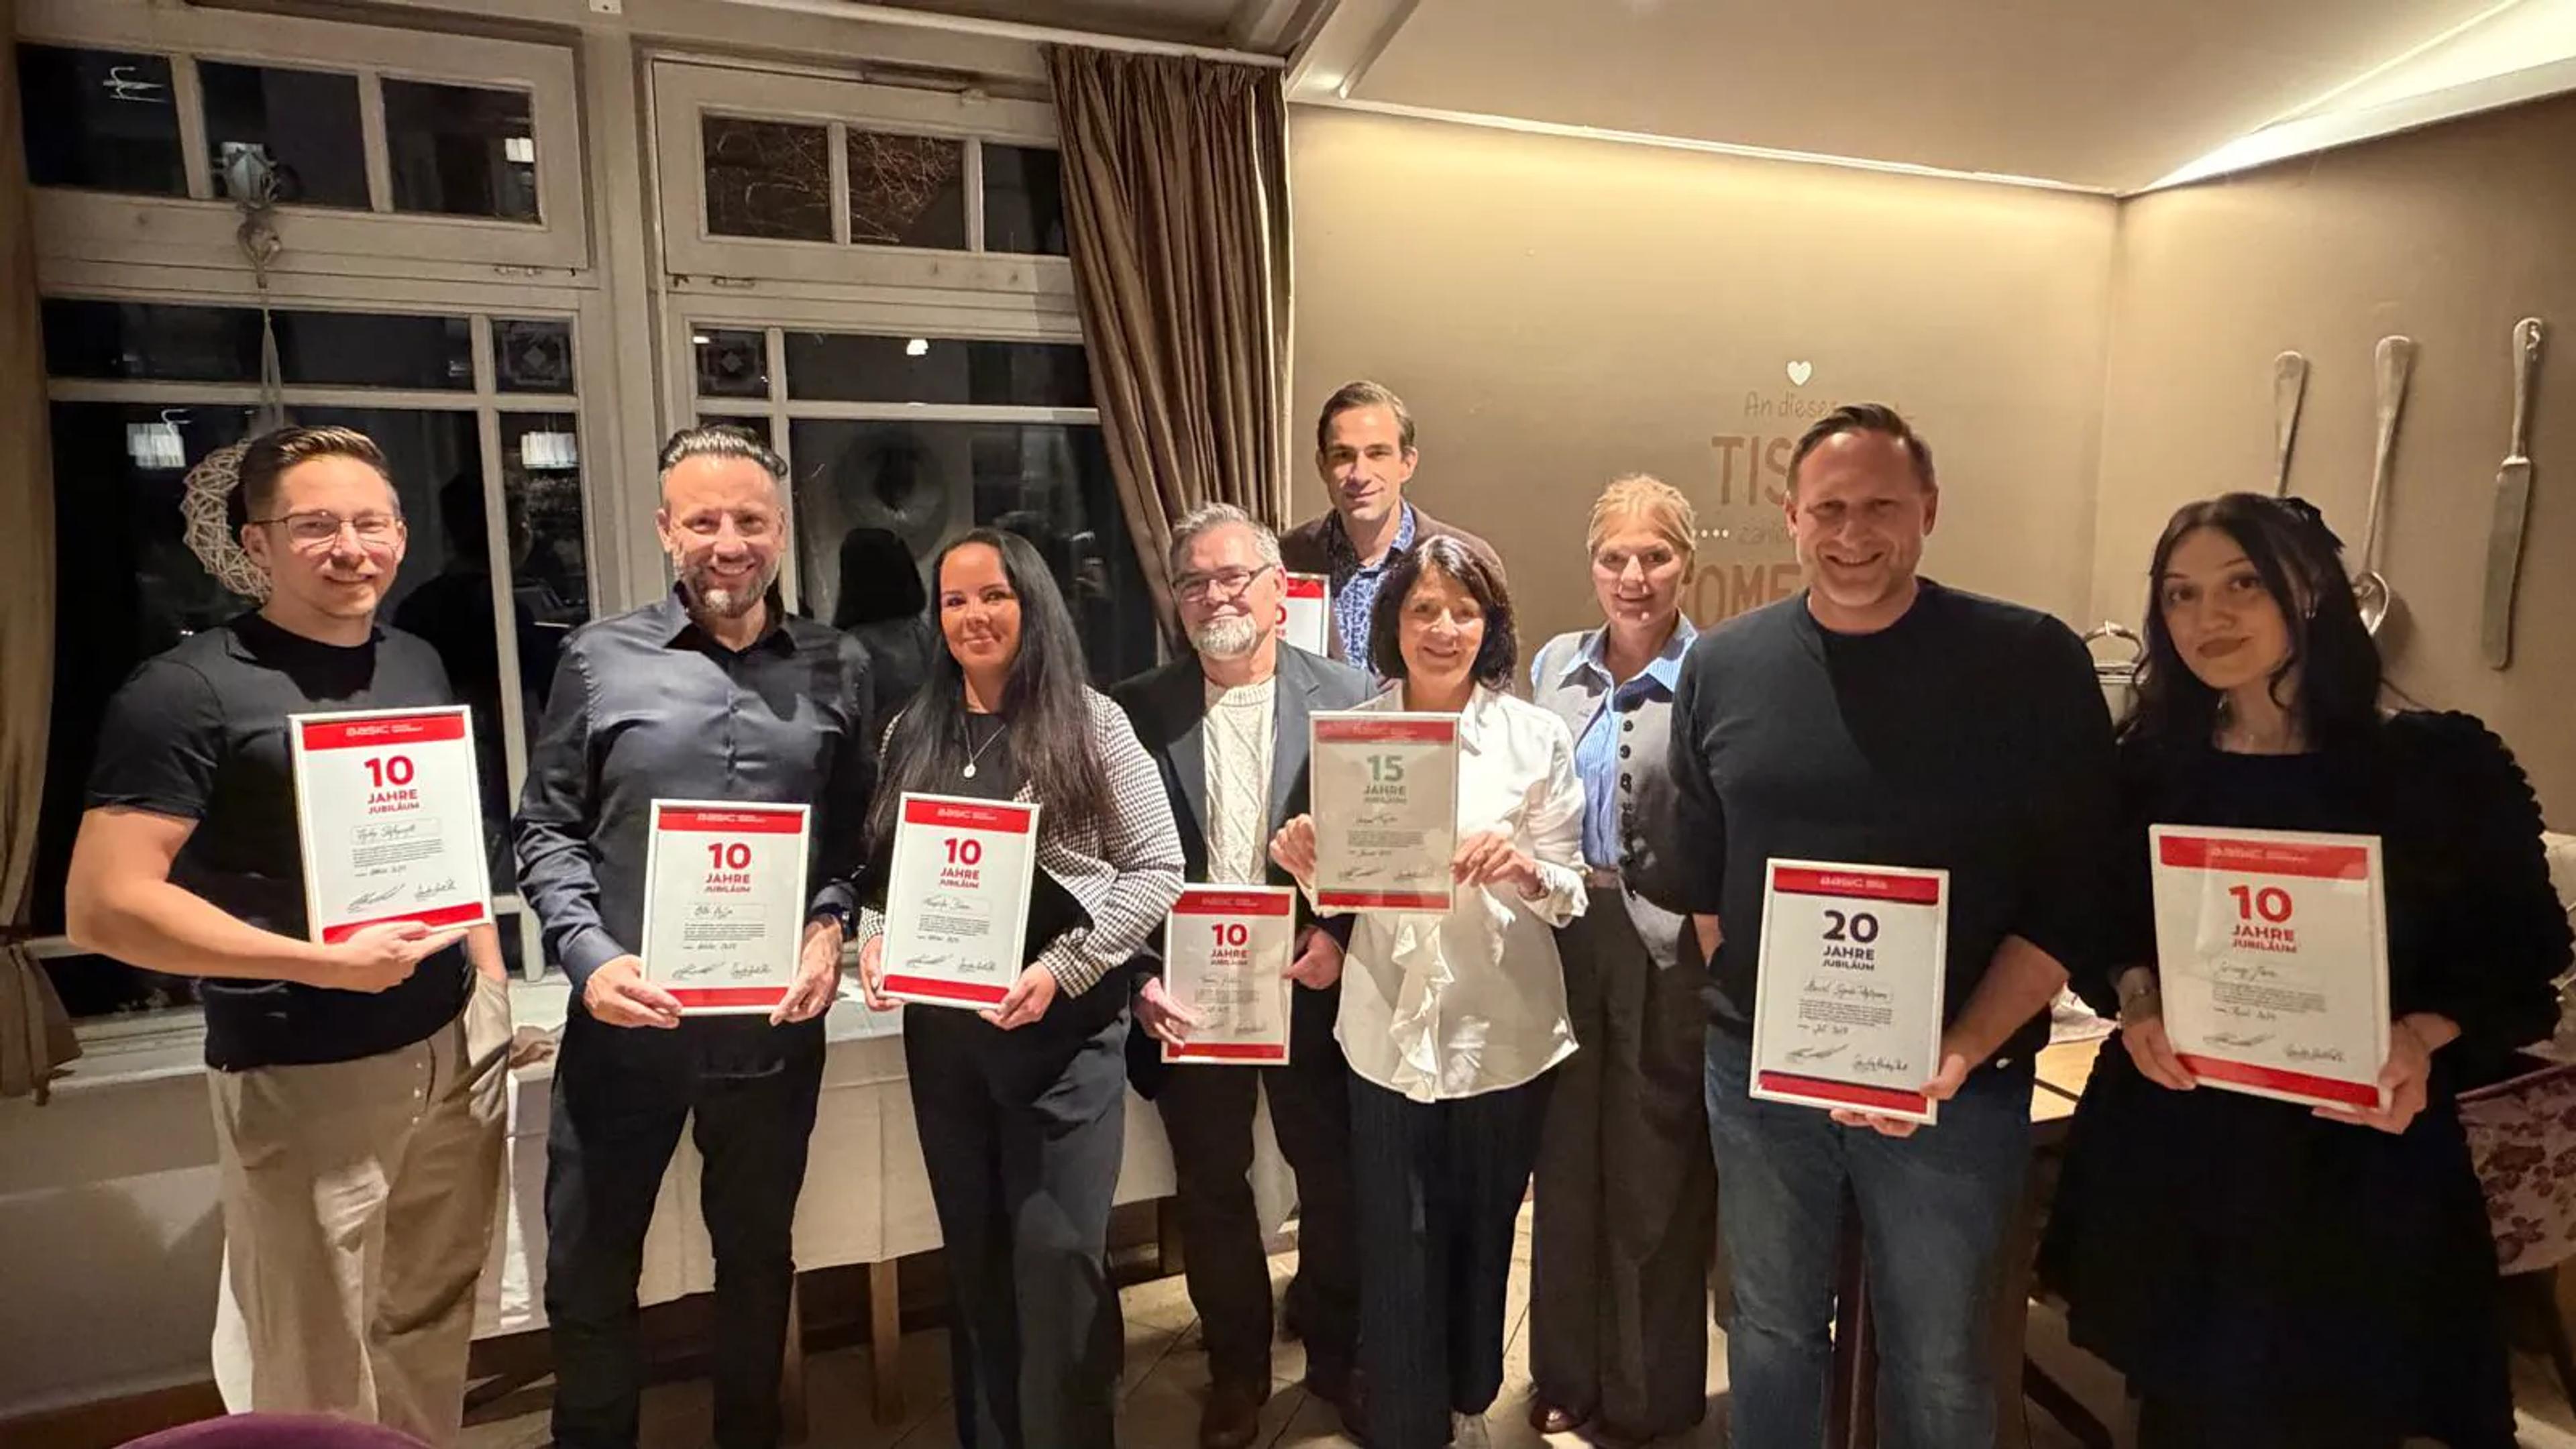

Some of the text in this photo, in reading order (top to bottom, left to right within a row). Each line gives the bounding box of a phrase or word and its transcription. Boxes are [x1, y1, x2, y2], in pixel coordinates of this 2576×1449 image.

[1711, 436, 1792, 507] TIS
[364, 755, 414, 788] 10
[1366, 755, 1403, 782] 15
[368, 789, 418, 804] JAHRE
[1364, 785, 1406, 796] JAHRE
[708, 843, 751, 869] 10
[945, 838, 981, 865] 10
[706, 873, 750, 883] JAHRE
[940, 868, 979, 880] JAHRE
[2229, 884, 2293, 923] 10
[1212, 923, 1248, 946] 10
[1822, 910, 1878, 944] 20
[2232, 924, 2295, 942] JAHRE
[1823, 945, 1875, 961] JAHRE
[1823, 959, 1875, 971] JUBILÄUM
